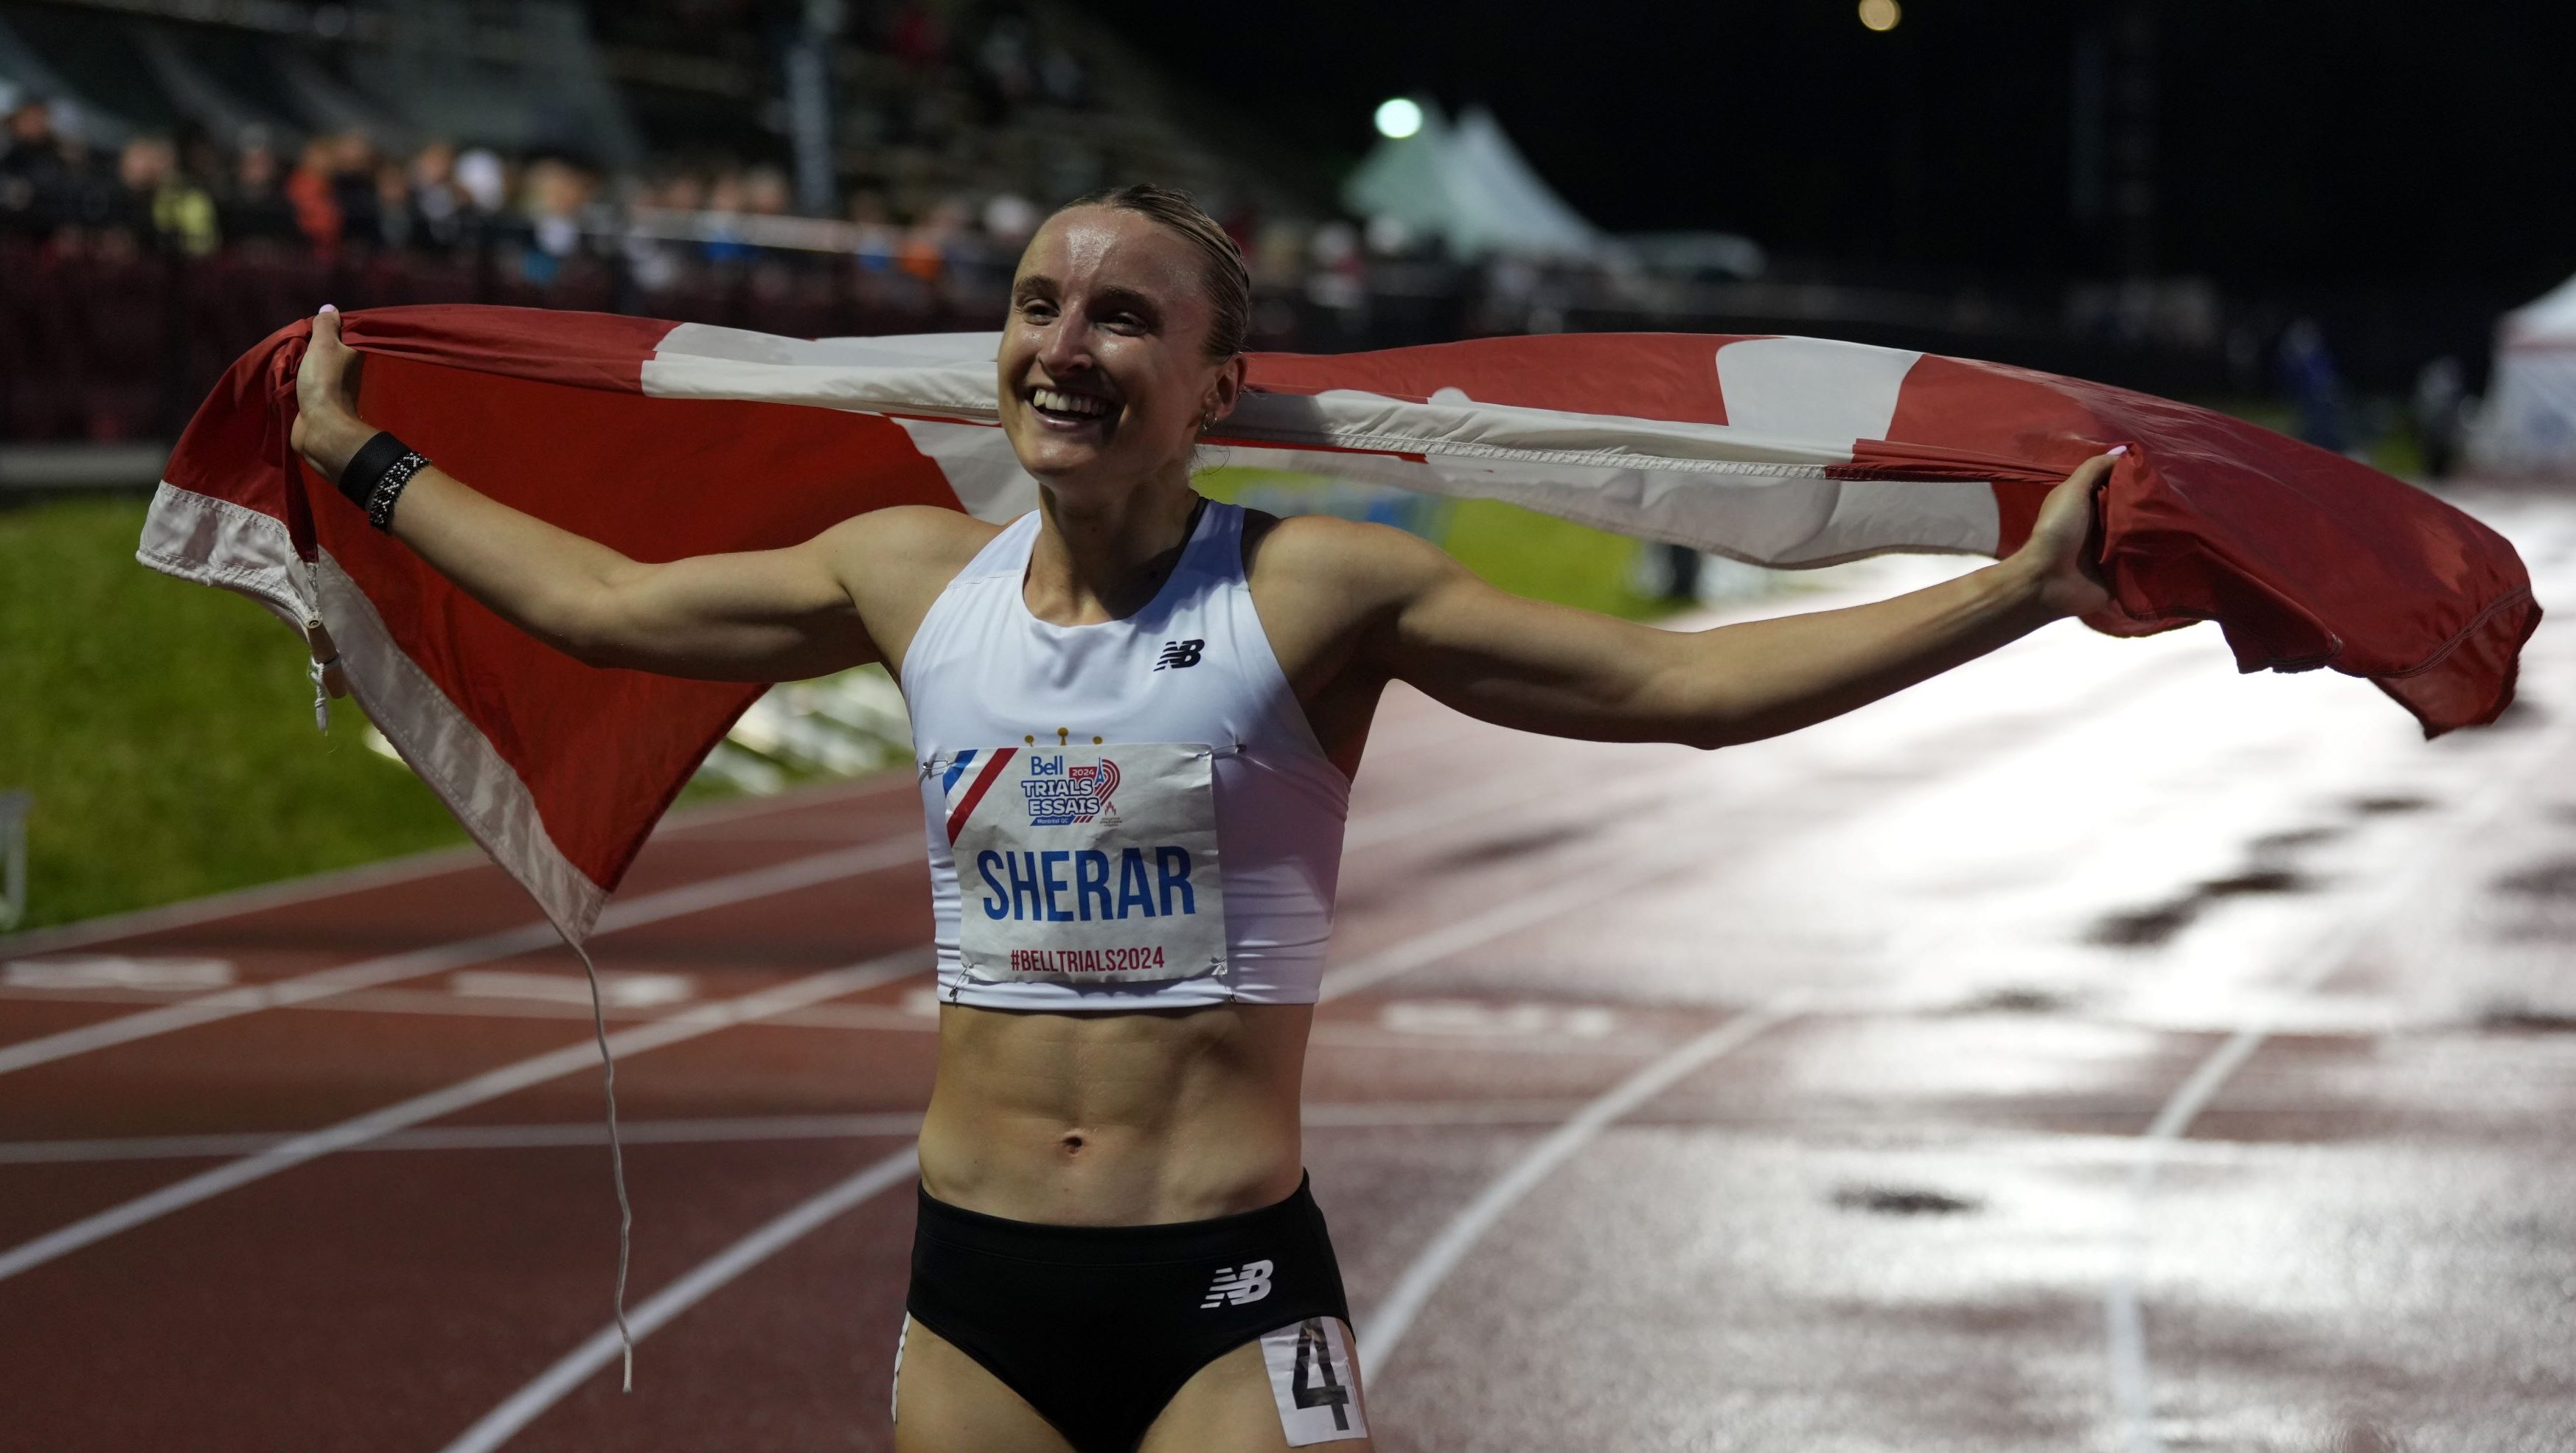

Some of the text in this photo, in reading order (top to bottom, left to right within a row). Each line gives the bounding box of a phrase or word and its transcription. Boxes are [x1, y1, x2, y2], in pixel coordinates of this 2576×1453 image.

[1031, 756, 1063, 776] Bell
[1021, 779, 1093, 798] TRIALS
[1028, 798, 1100, 816] ESSAIS
[977, 846, 1195, 921] SHERAR
[1011, 947, 1164, 972] #BELLTRIALS2024
[1292, 1317, 1350, 1431] 4
